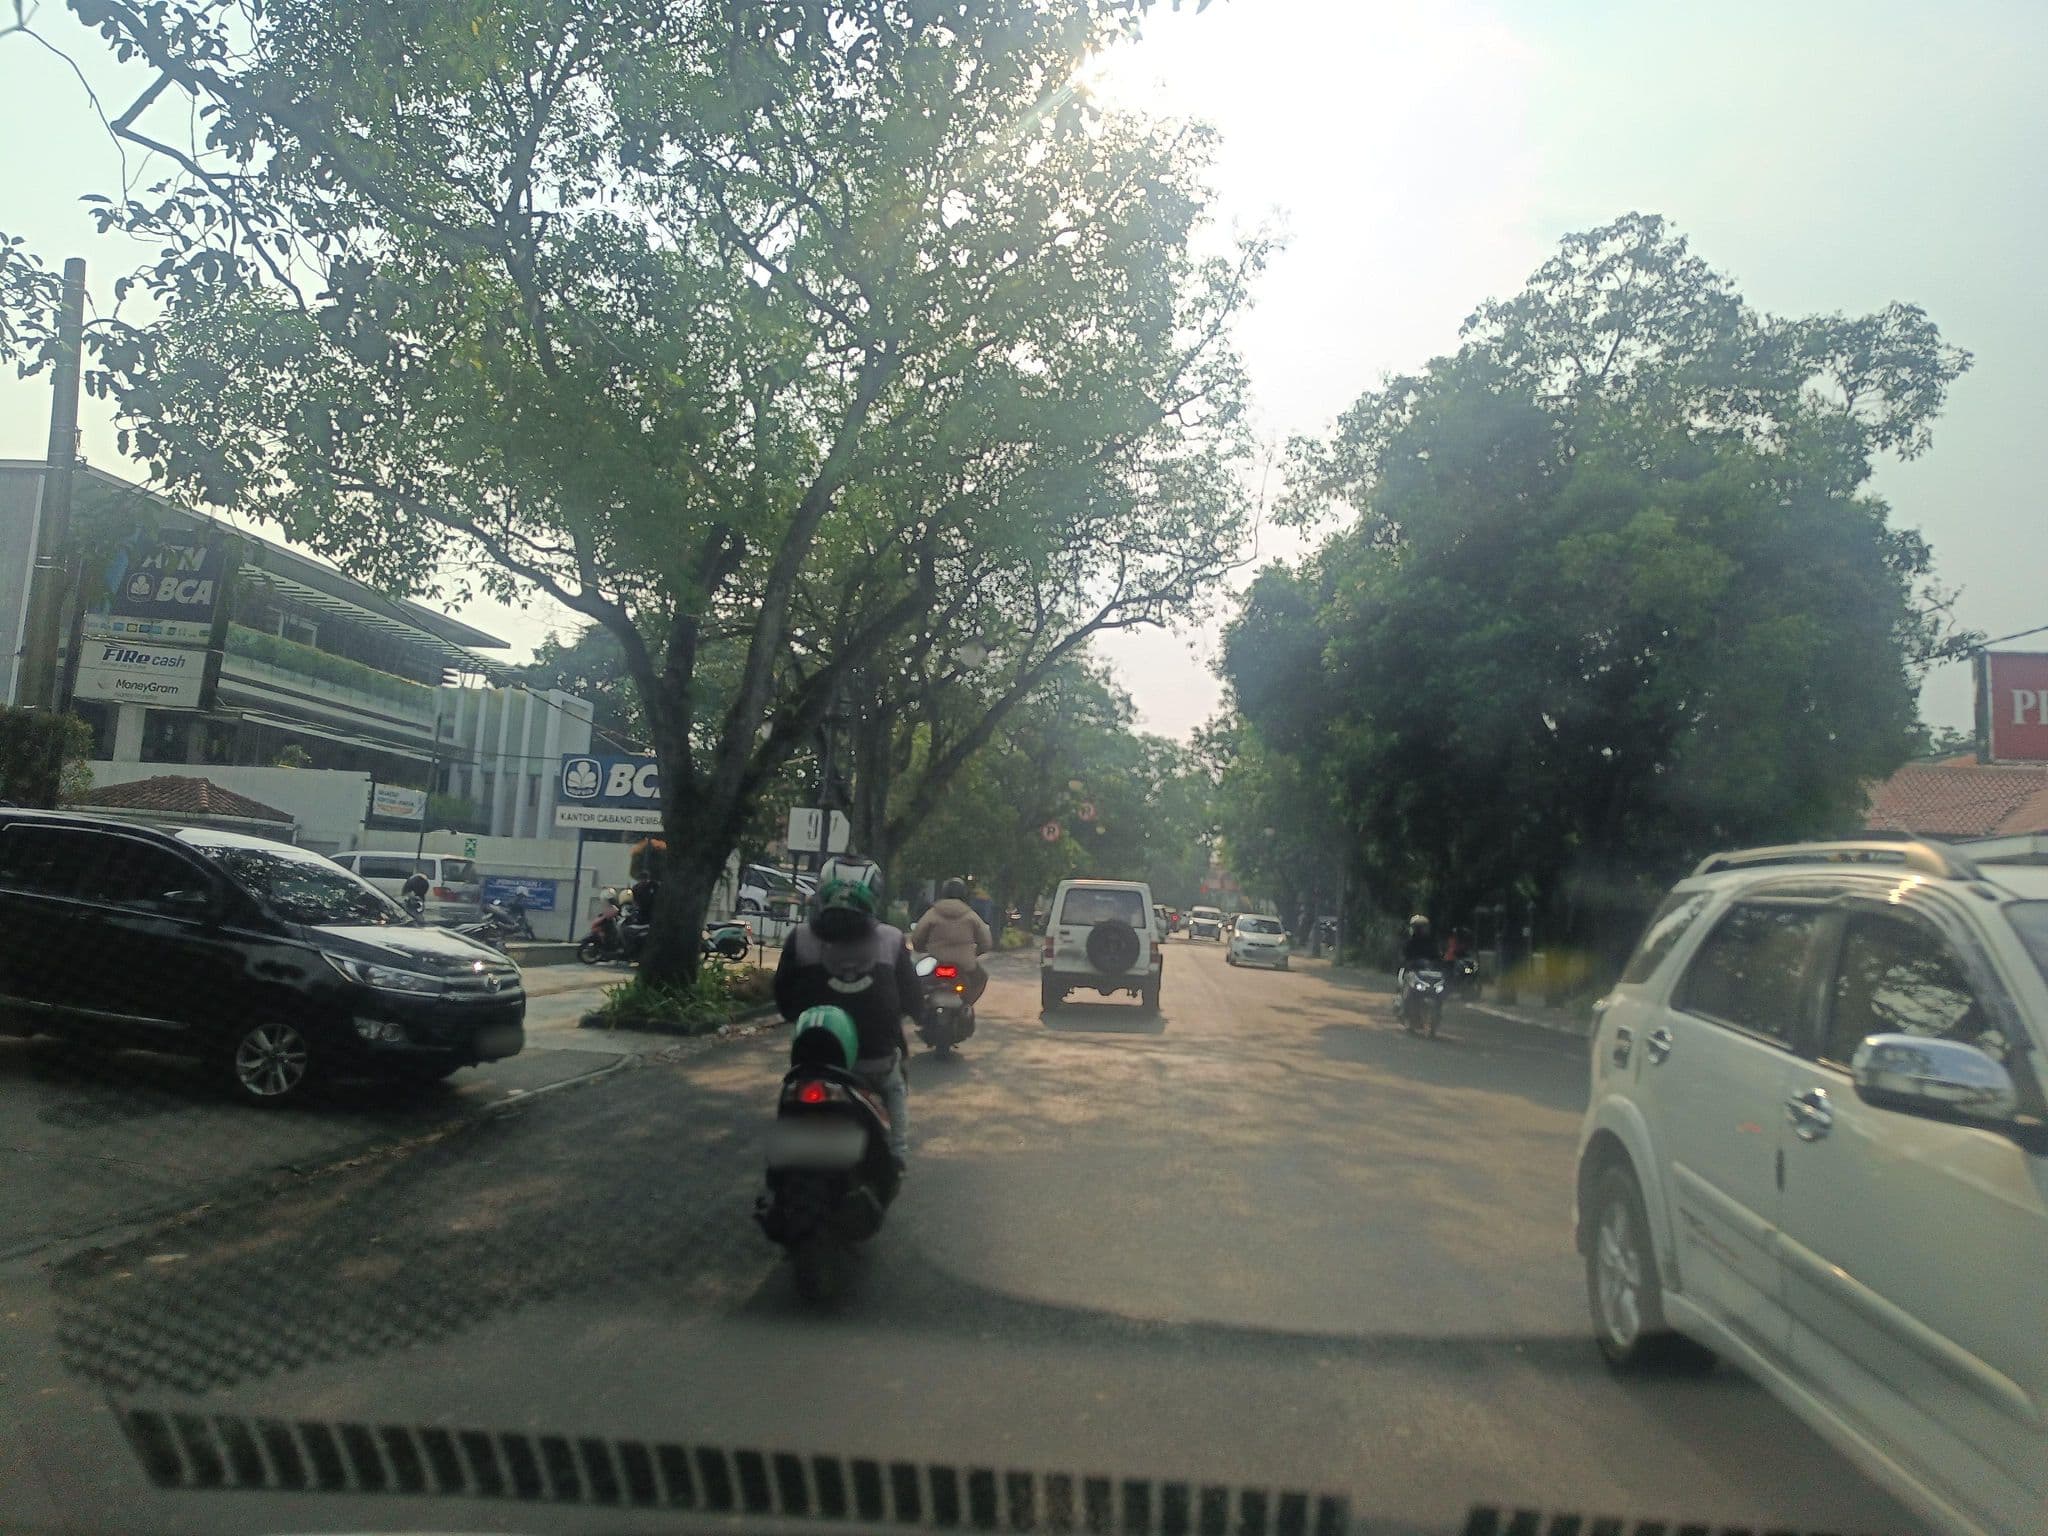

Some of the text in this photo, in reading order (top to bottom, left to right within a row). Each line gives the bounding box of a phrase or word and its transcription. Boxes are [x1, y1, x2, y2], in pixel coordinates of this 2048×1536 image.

[155, 577, 213, 605] BCA
[151, 655, 186, 668] cash
[115, 679, 179, 694] MoneyGram
[604, 763, 661, 798] BC
[560, 811, 595, 823] KANTOR
[597, 814, 632, 825] CABANG
